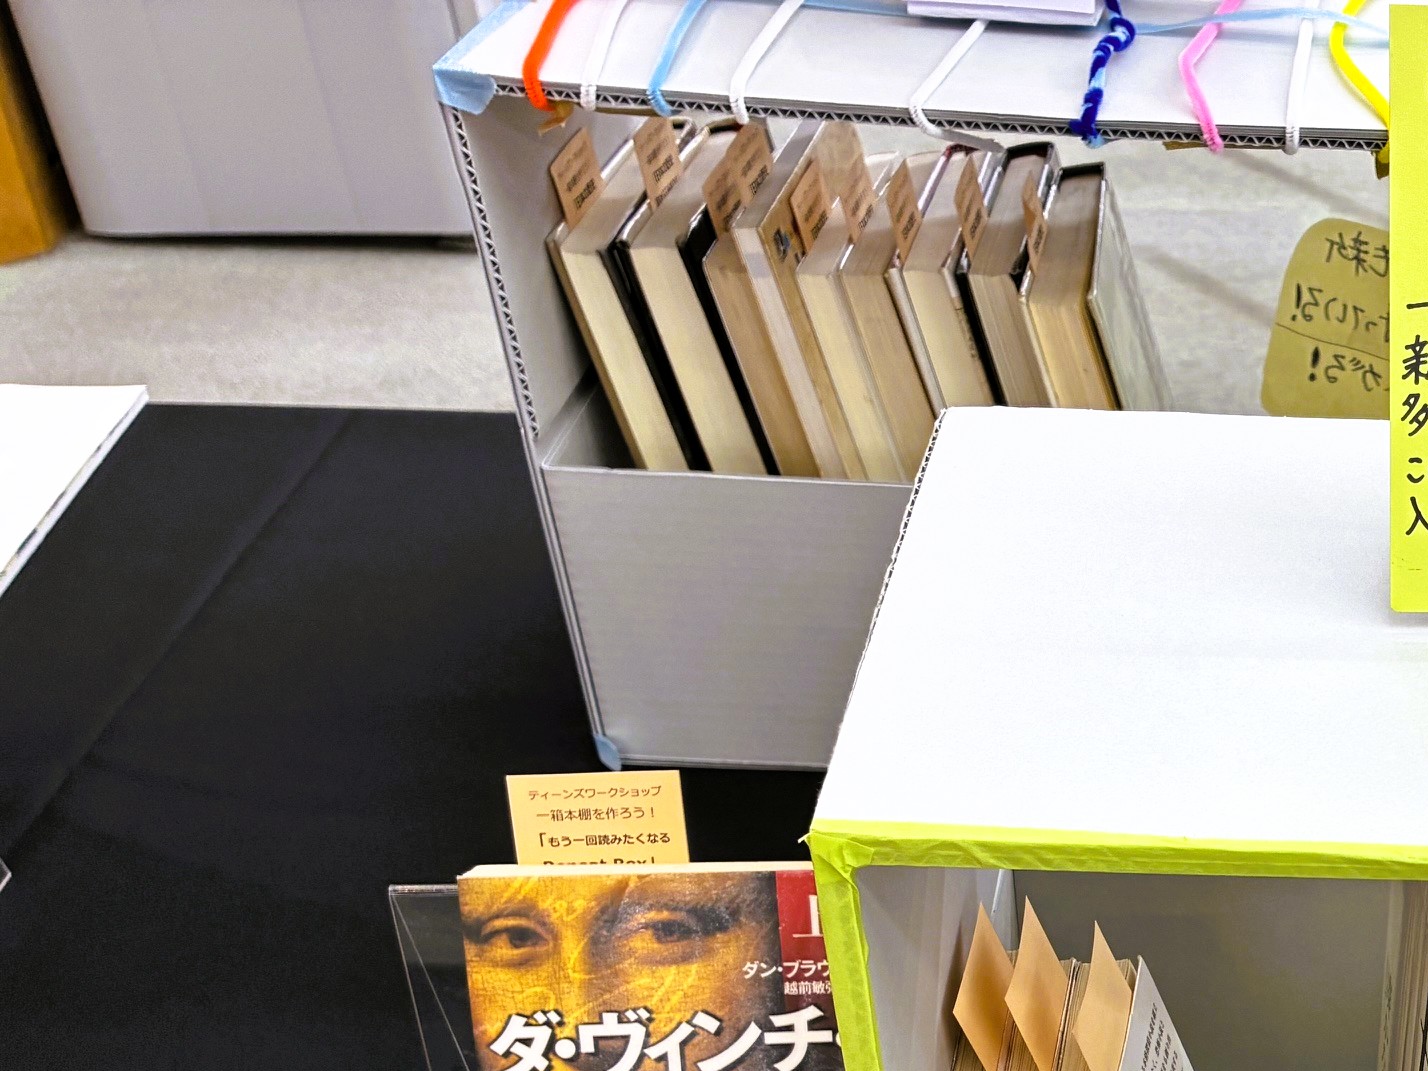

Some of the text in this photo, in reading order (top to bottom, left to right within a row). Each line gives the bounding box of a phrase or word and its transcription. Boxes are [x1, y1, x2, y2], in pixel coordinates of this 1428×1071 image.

[528, 785, 662, 801] ティーンズワークショップ
